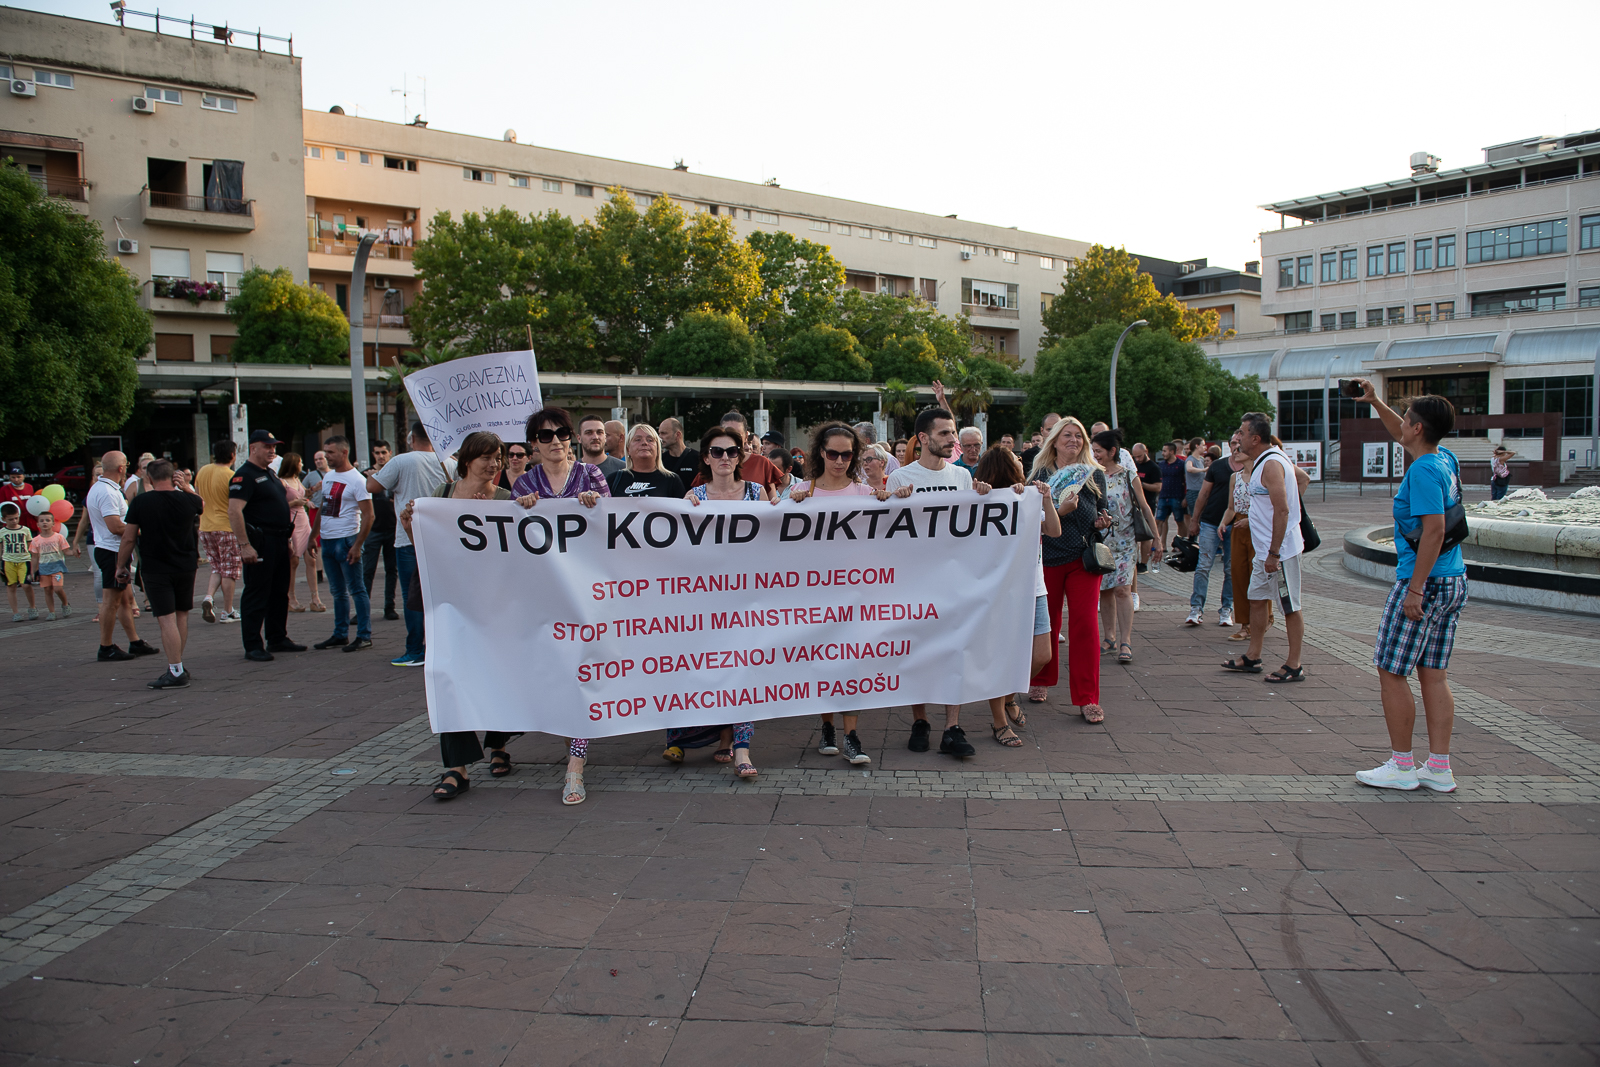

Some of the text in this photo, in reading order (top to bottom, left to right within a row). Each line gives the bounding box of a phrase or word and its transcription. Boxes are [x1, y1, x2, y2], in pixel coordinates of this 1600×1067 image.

[418, 365, 527, 407] NE OBAVEZNA
[435, 387, 534, 423] VAKCINACIJA
[630, 482, 651, 490] NIKE
[4, 533, 25, 544] SUM
[457, 501, 1019, 555] STOP KOVID DIKTATURI
[5, 543, 26, 553] MER
[592, 567, 895, 601] STOP TIRANIJI NAD DJECOM
[552, 603, 939, 643] STOP TIRANIJI MAINSTREAM MEDIJA
[577, 640, 911, 683] STOP OBAVEZNOJ VAKCINACIJI
[589, 673, 900, 721] STOP VAKCINALNOM PASOŠU
